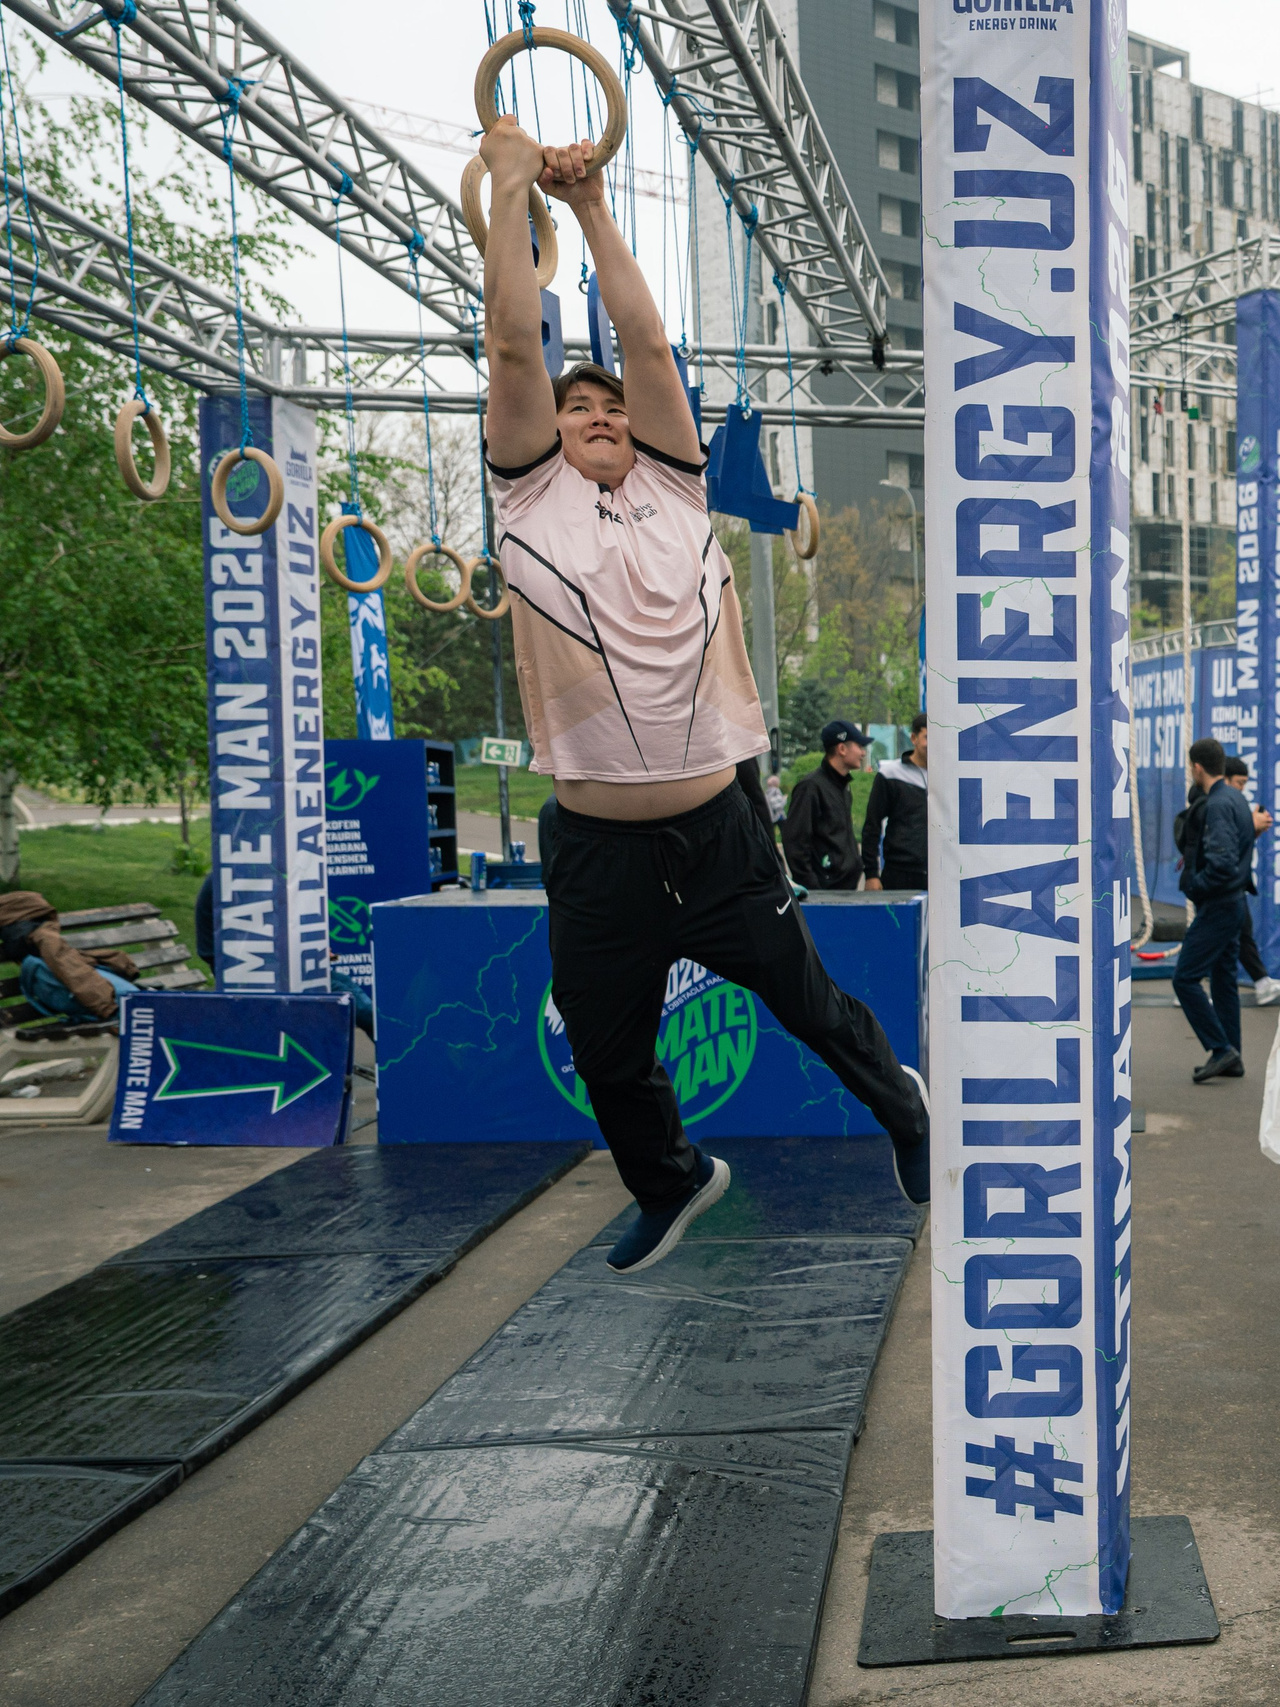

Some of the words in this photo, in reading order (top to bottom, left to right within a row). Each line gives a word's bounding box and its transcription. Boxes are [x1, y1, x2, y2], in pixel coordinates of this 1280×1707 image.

[969, 18, 1016, 31] ENERGY
[1019, 17, 1058, 31] DRINK
[1238, 481, 1260, 584] 2026
[1237, 599, 1259, 690] MAN
[214, 683, 272, 810] MAN
[287, 502, 330, 993] RILLAENERGY.UZ
[953, 75, 1085, 1522] #GORILLAENERGY.UZ
[327, 842, 368, 853] UARANA
[327, 853, 368, 865] ENSHEN
[219, 834, 276, 993] MATE
[667, 983, 706, 1011] OBSTACLE
[705, 975, 725, 986] RAC
[126, 1007, 154, 1087] ULTIMATE
[119, 1090, 147, 1130] MAN
